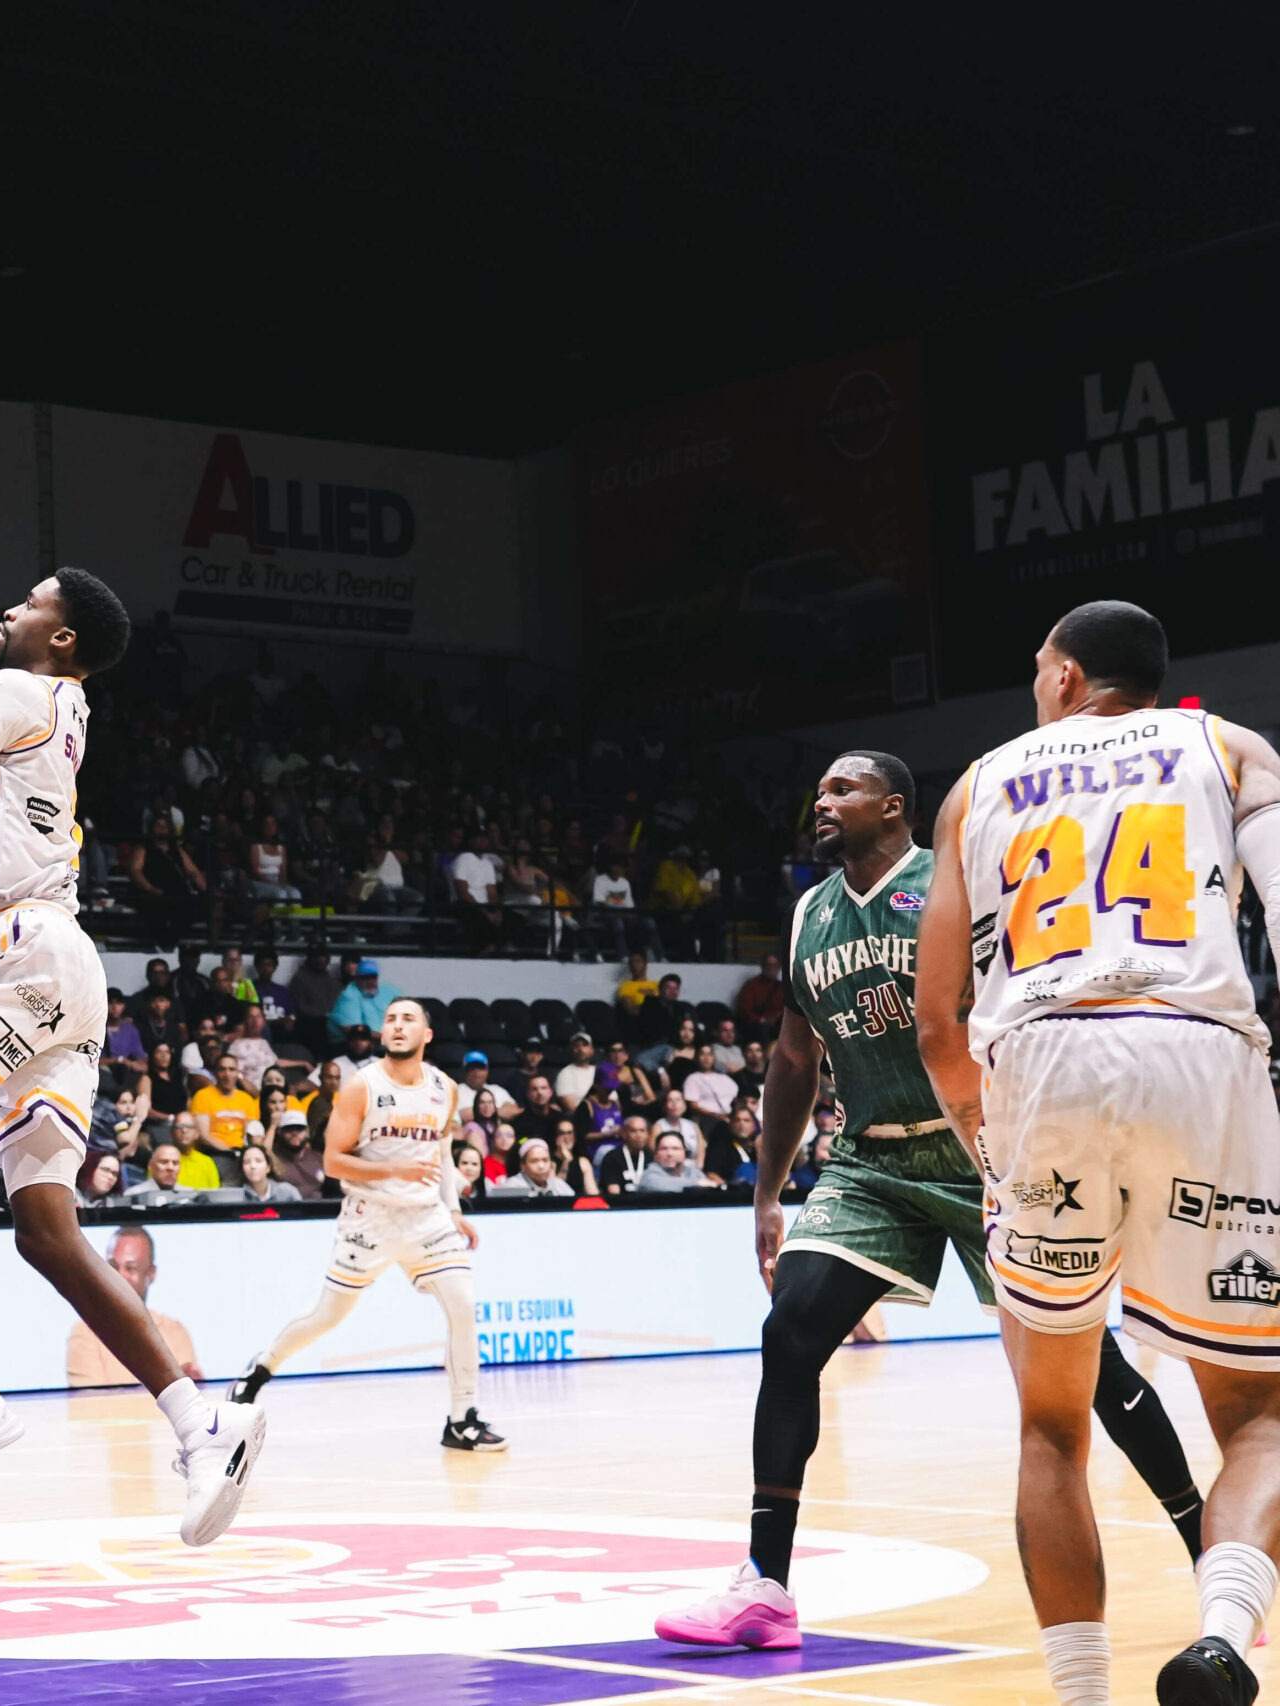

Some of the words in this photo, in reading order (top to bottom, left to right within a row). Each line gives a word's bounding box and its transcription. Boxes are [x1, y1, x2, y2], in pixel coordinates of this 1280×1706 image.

[1081, 360, 1176, 441] LA
[182, 433, 417, 559] ALLIED
[970, 405, 1280, 554] FAMILIA
[180, 555, 233, 585] Car
[237, 560, 257, 589] &
[260, 562, 329, 596] Truck
[335, 568, 417, 602] Rental
[1001, 747, 1184, 817] WILEY
[27, 811, 48, 824] ESPA
[999, 802, 1196, 979] 24
[803, 934, 918, 1002] MAYAGÜE
[12, 983, 50, 1018] TOURISM
[856, 980, 912, 1038] 34
[1213, 1193, 1280, 1216] rav
[1215, 1219, 1280, 1236] ubrica
[475, 1301, 491, 1323] EN
[497, 1301, 513, 1322] TU
[518, 1298, 575, 1322] ESQUINA
[477, 1329, 575, 1365] SIEMPRE
